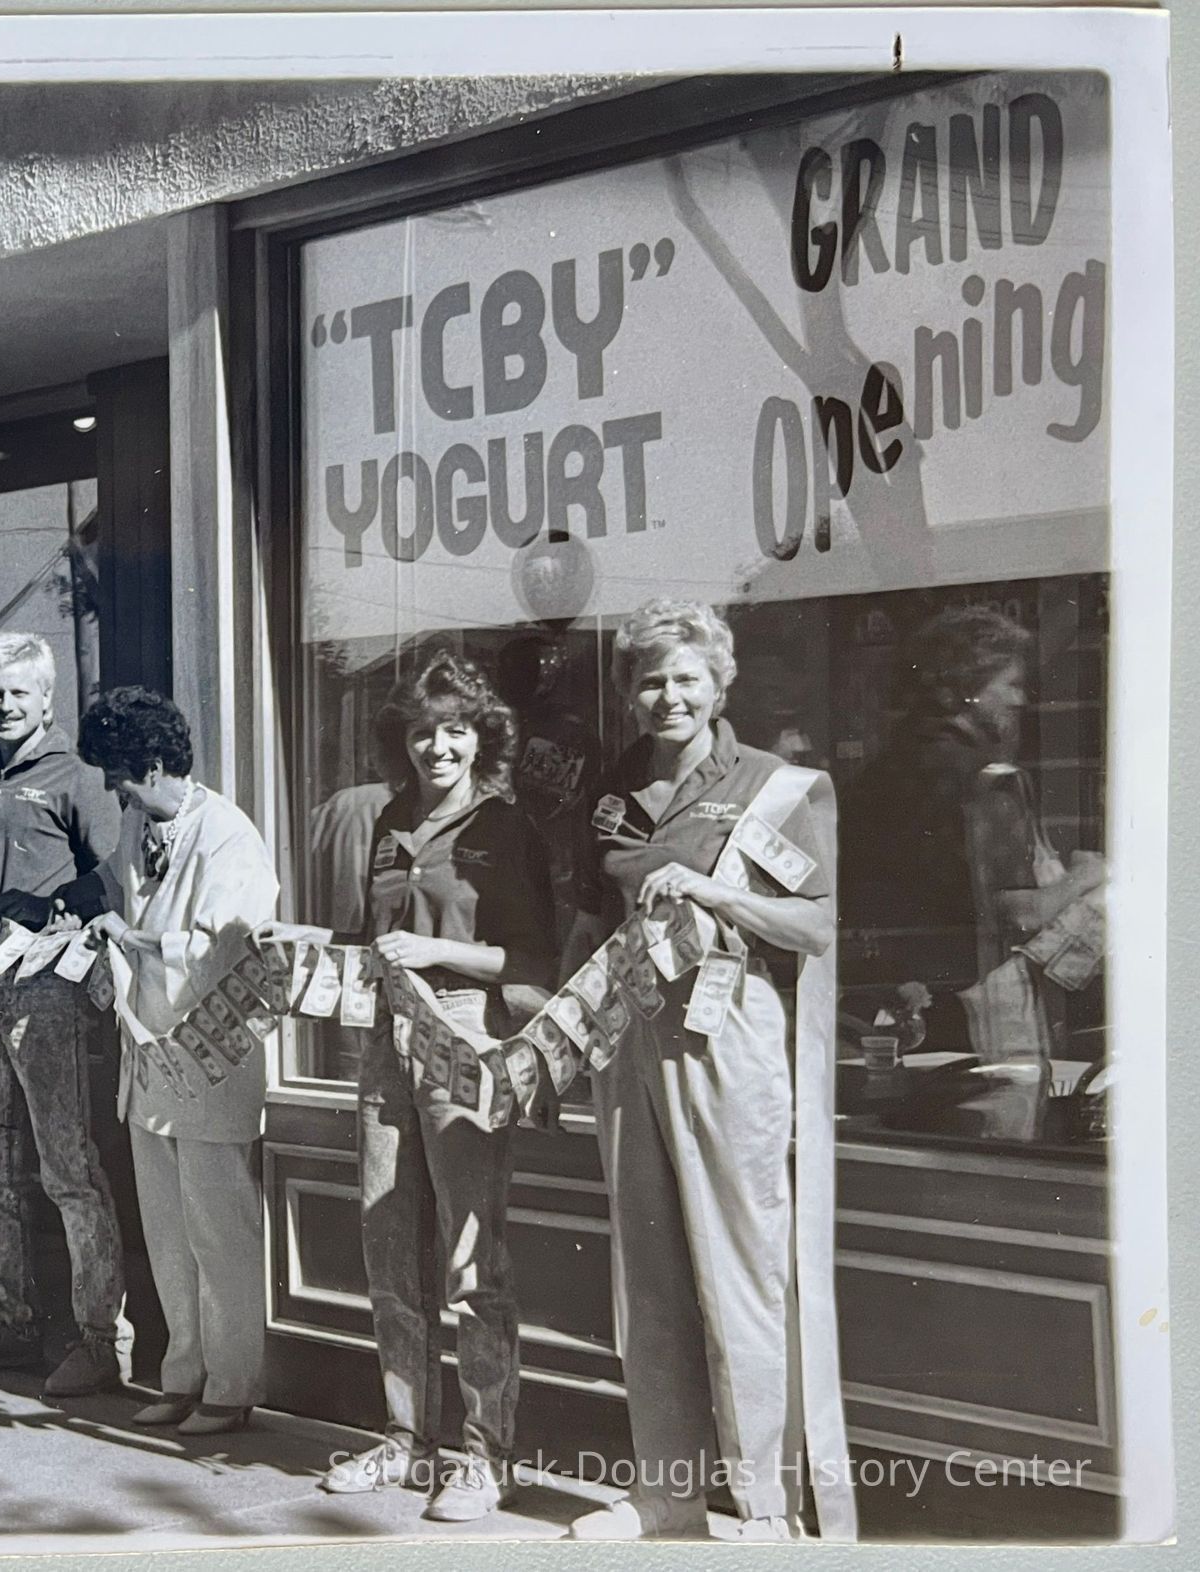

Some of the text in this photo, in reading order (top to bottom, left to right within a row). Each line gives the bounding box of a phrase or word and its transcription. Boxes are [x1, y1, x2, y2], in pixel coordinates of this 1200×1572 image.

[791, 93, 1064, 292] GRAND
[325, 411, 662, 568] YOGURT
[752, 258, 1106, 562] Opening
